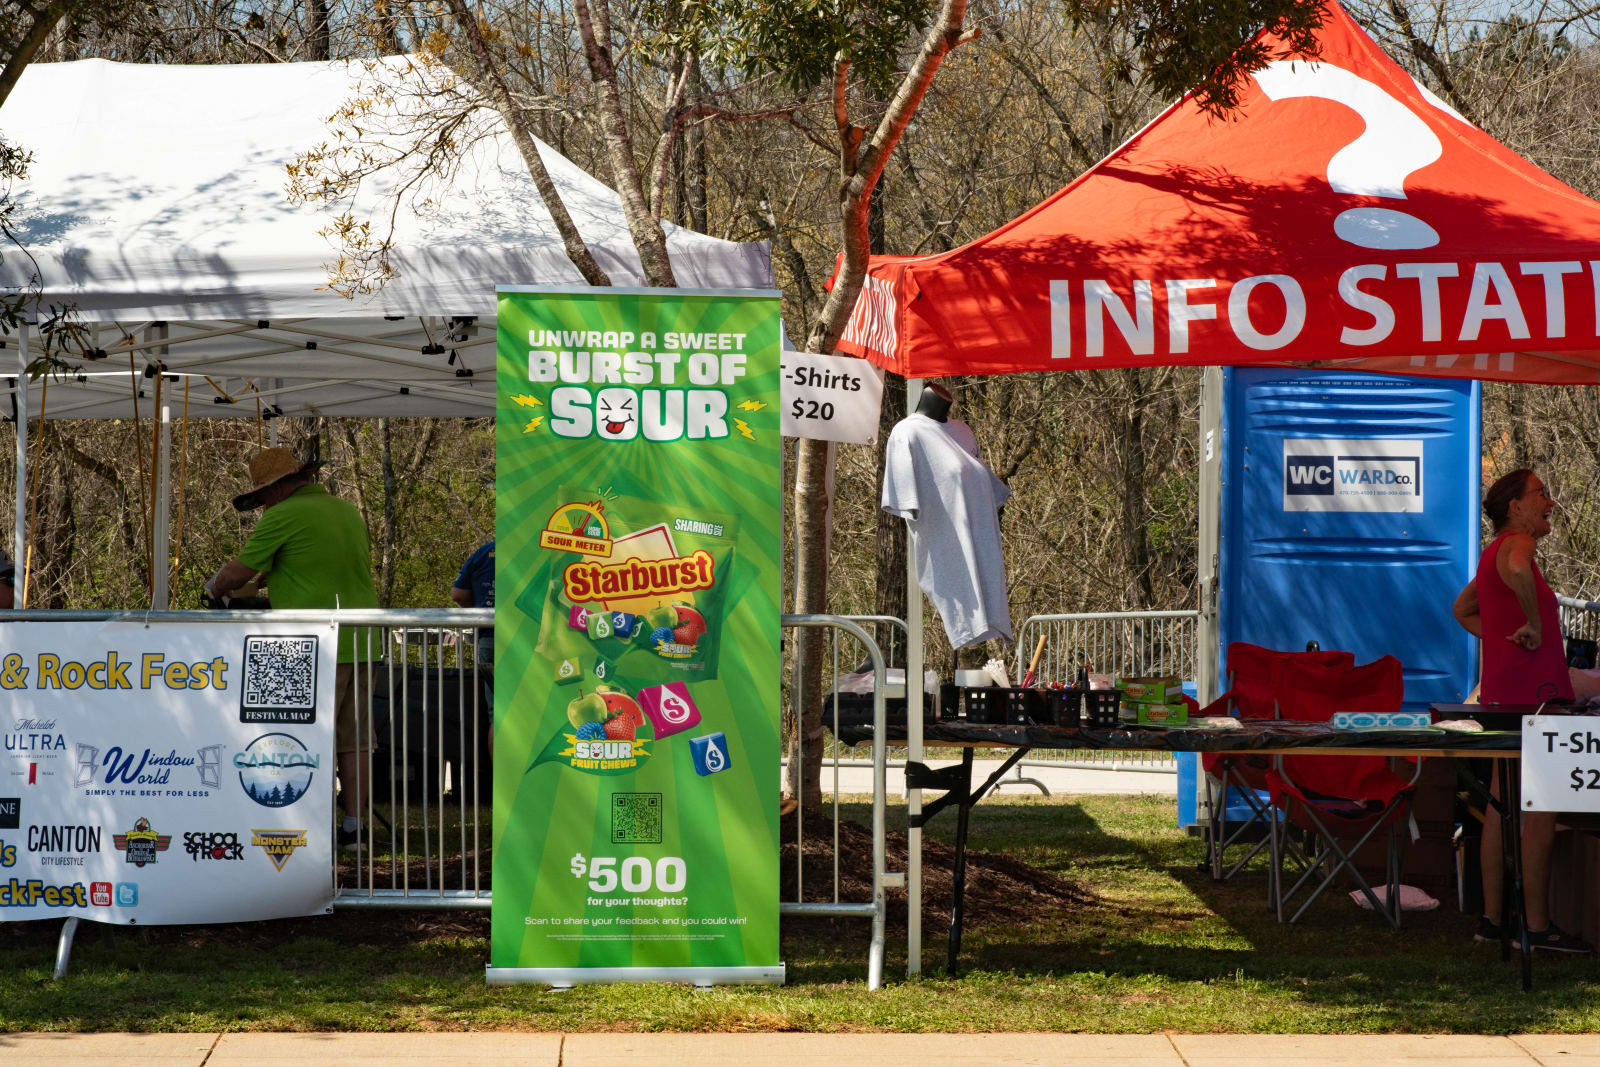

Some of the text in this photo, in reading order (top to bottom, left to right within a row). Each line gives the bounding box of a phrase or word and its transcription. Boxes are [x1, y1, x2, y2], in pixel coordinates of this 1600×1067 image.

[1049, 274, 1307, 359] INFO
[528, 329, 747, 350] UNWRAP A SWEET
[528, 350, 747, 385] BURST OF
[781, 365, 861, 391] -Shirts
[550, 386, 729, 441] SOUR
[791, 397, 835, 420] $20
[1289, 465, 1332, 485] WC
[674, 518, 714, 535] SHARING
[547, 535, 606, 552] SOUR METER
[568, 554, 709, 597] Starburst
[0, 651, 229, 690] & Rock Fest
[246, 711, 311, 720] FESTIVAL MAP
[5, 733, 66, 751] ULTRA
[575, 741, 633, 760] SOUR
[233, 752, 320, 770] CANTON
[571, 758, 637, 769] FRUIT CHEWS
[28, 825, 101, 853] CANTON
[183, 831, 242, 848] SCHOOL
[251, 837, 307, 847] MONSTER
[201, 845, 244, 860] ROCK
[266, 846, 292, 855] JAM
[41, 856, 84, 866] CITY LIFESTYLE
[570, 853, 687, 893] $500
[95, 883, 107, 892] You
[587, 896, 688, 908] for your thoughts?
[524, 916, 747, 926] Scan to share your feedback and you could win!
